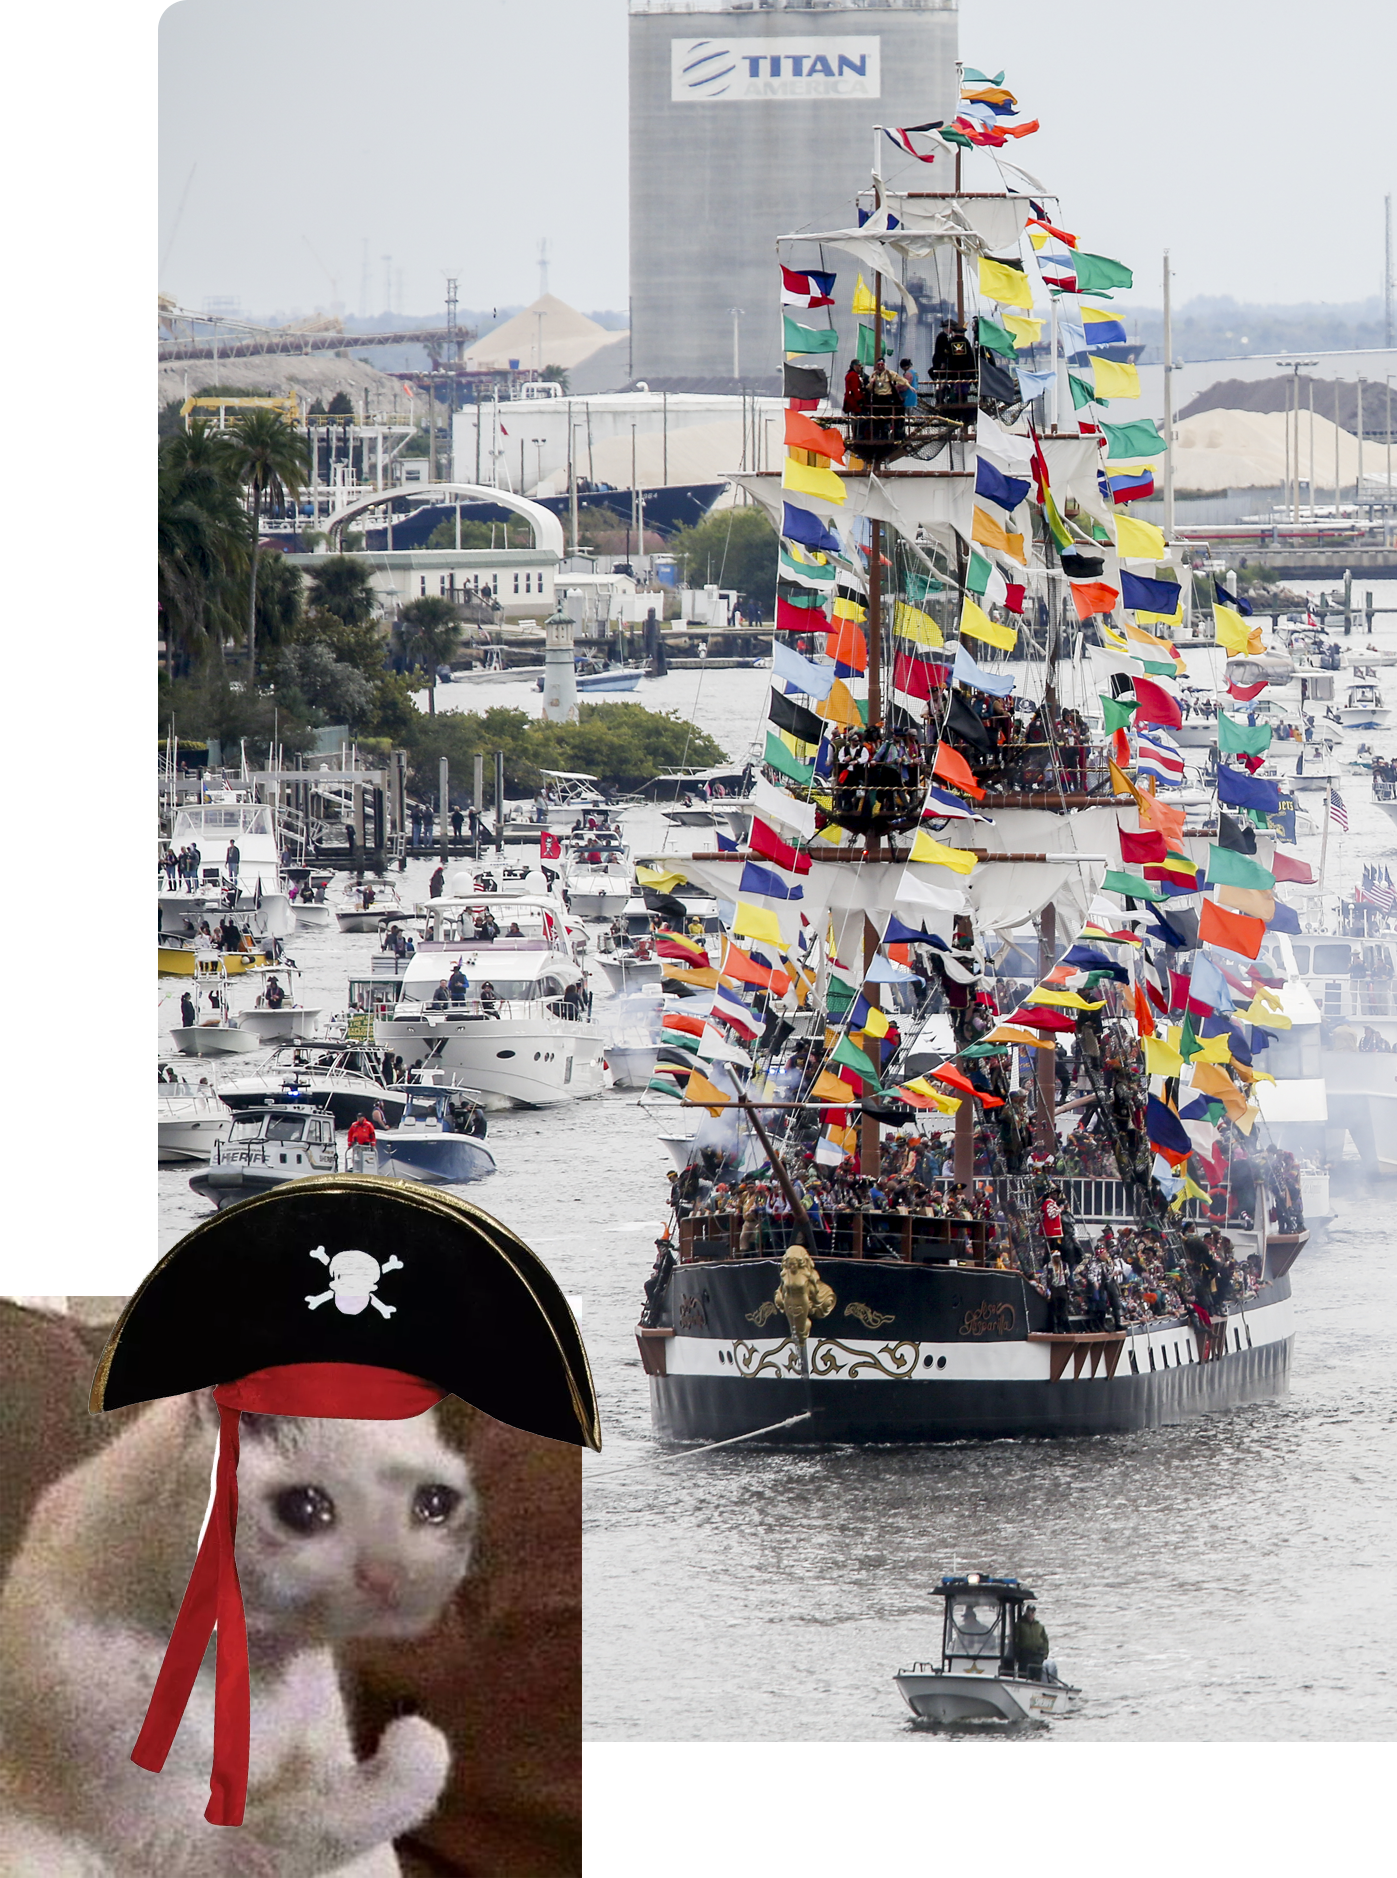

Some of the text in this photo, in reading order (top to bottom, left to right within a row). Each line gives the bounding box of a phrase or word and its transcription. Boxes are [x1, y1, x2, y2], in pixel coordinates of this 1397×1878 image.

[742, 54, 867, 77] TITAN
[744, 79, 869, 96] AMERICA
[212, 1152, 270, 1164] SHERIFF
